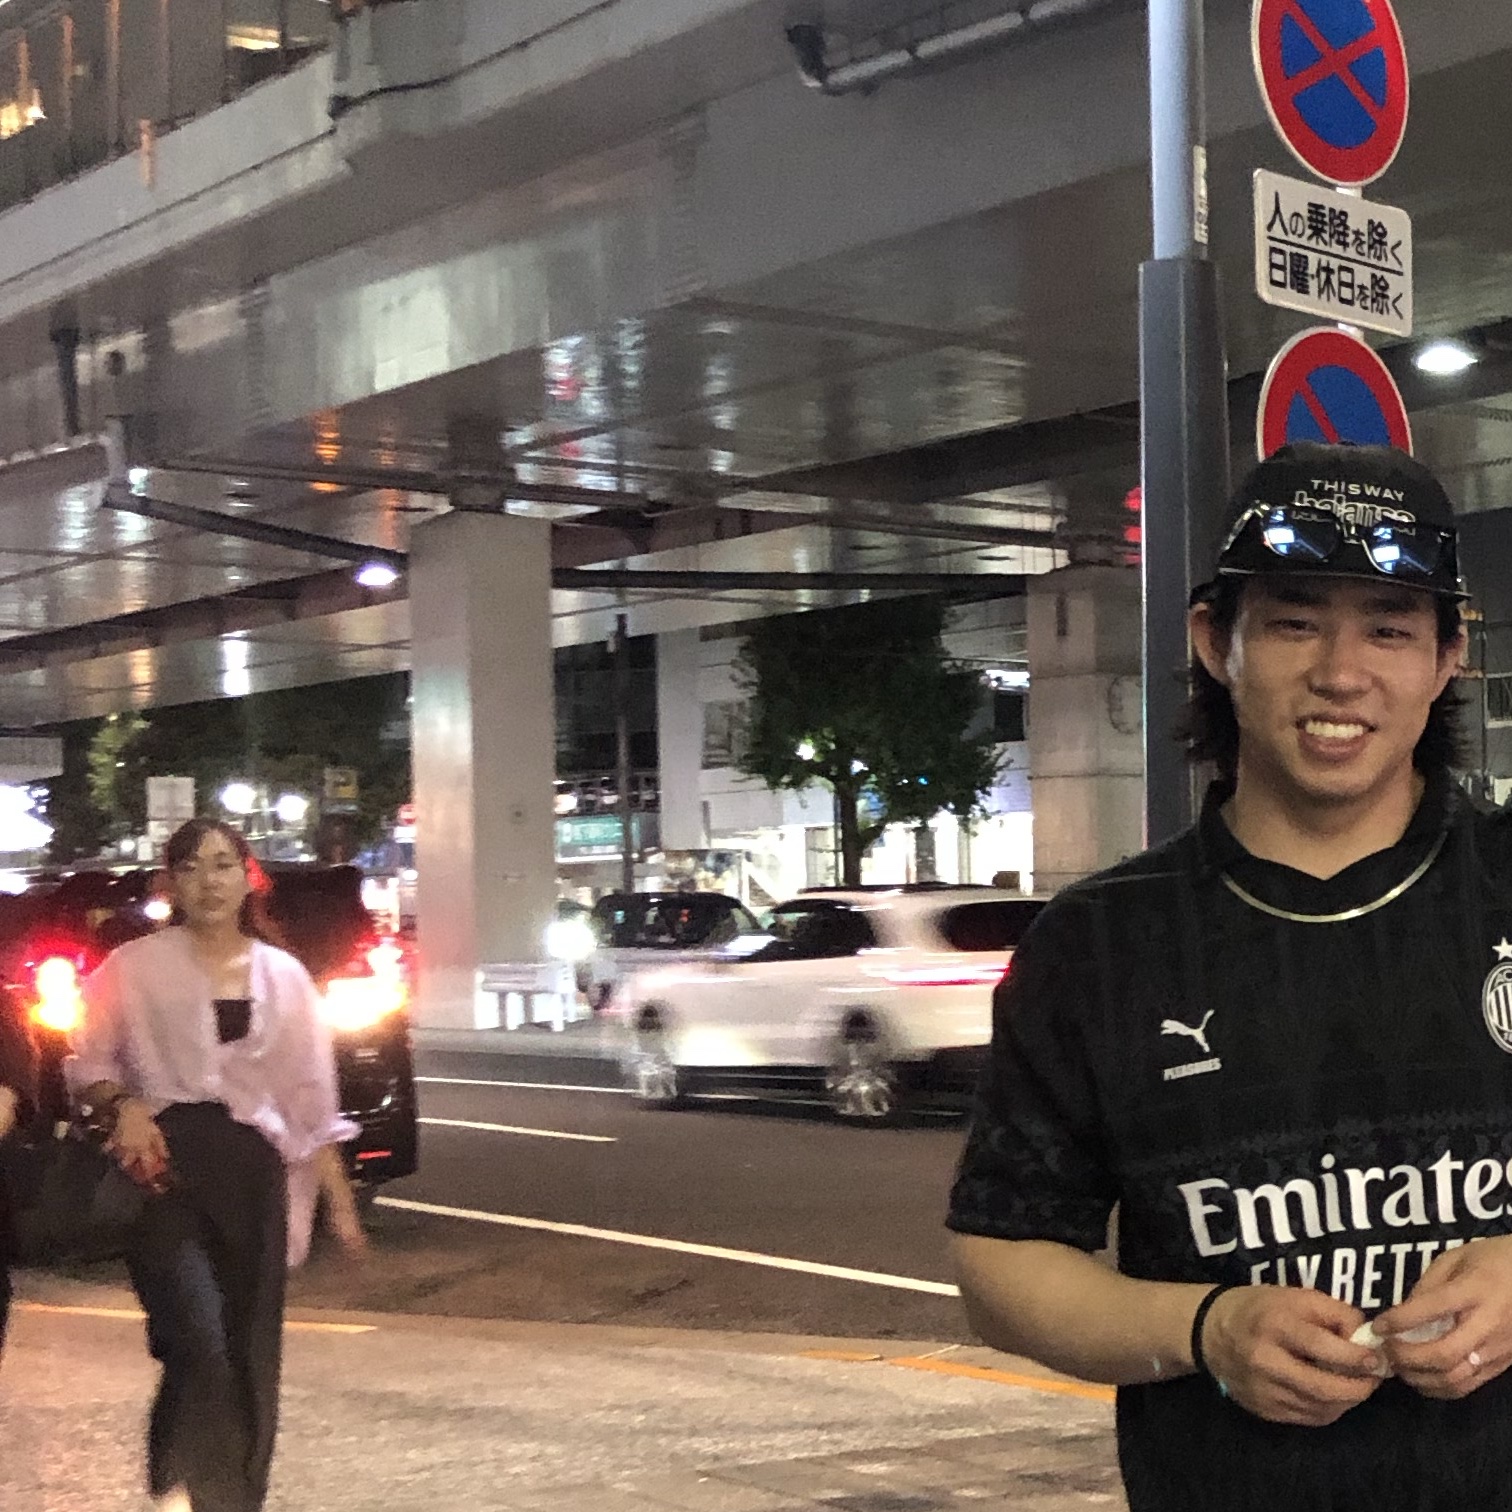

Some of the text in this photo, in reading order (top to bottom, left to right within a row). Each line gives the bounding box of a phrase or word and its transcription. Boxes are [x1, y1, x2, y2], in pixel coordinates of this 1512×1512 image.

[1266, 191, 1403, 267] 人の乗降を除く
